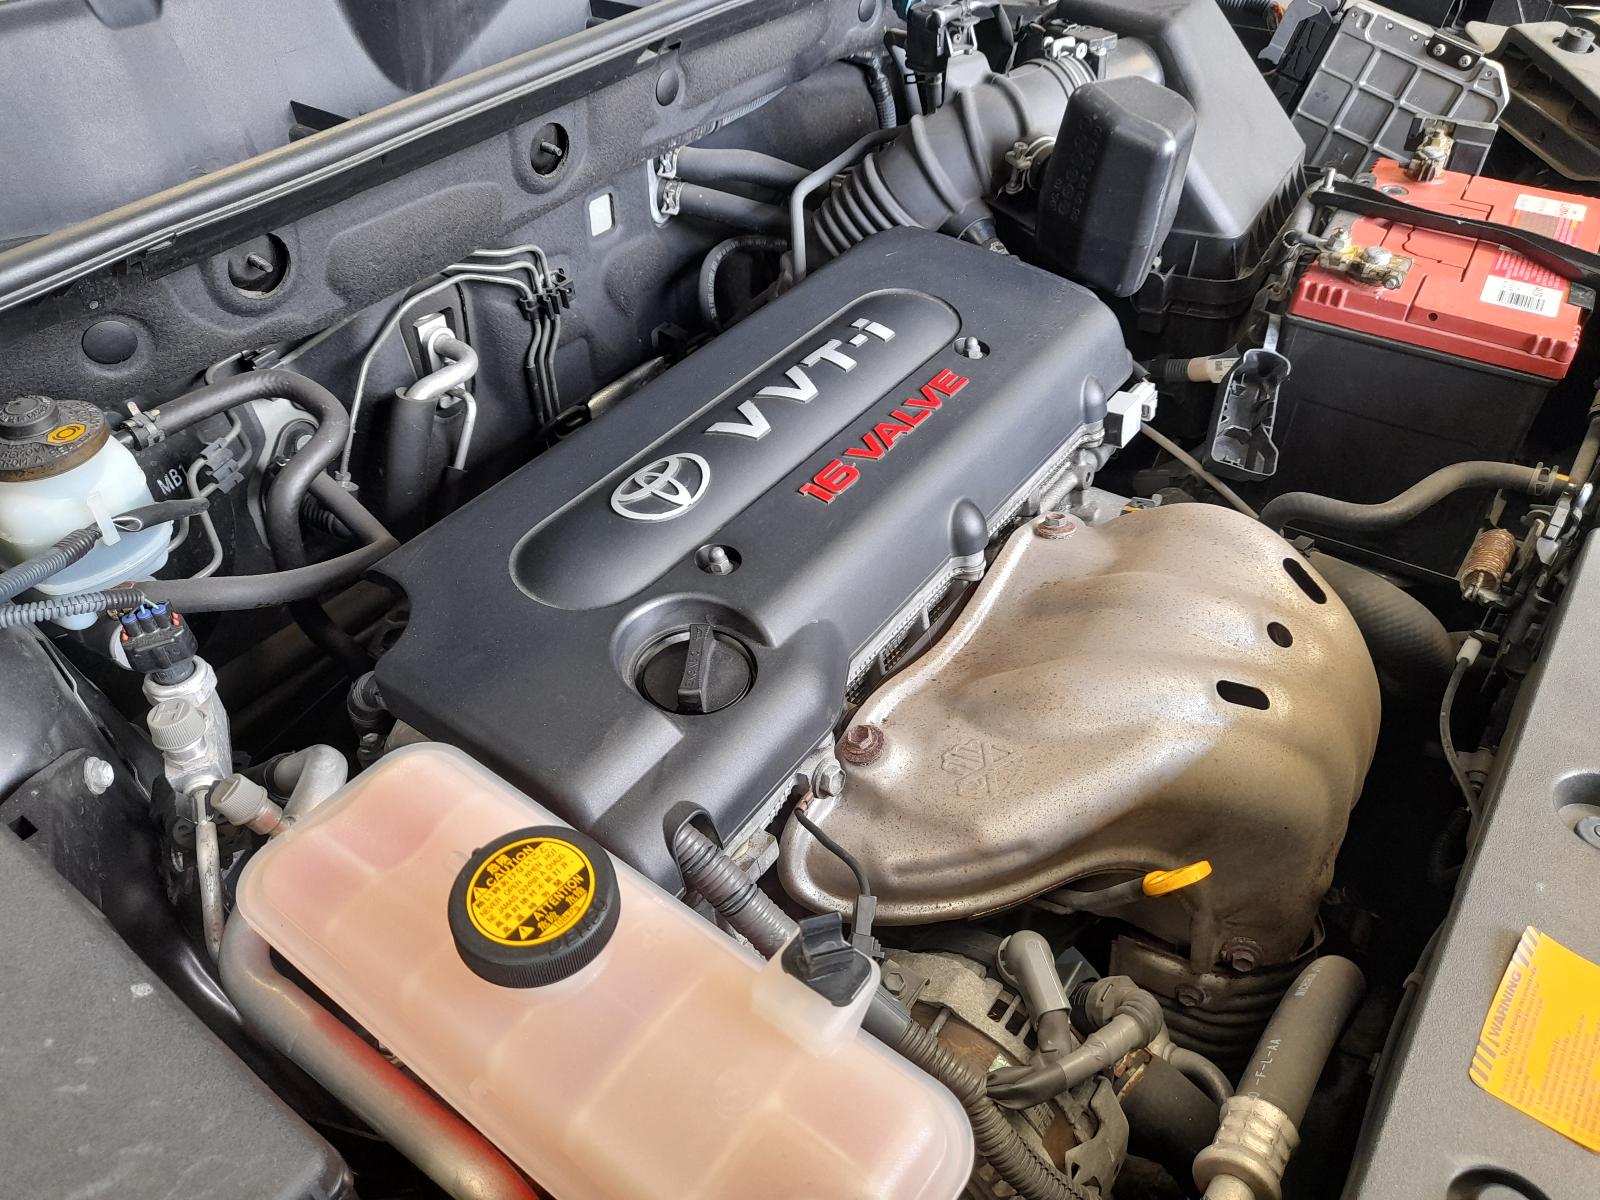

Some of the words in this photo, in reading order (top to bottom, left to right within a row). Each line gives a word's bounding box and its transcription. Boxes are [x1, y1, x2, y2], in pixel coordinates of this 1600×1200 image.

[704, 318, 896, 440] VVT-i
[798, 458, 861, 504] 16
[842, 368, 970, 460] VALVE
[486, 845, 535, 887] CAUTION
[533, 873, 585, 921] ATTENTION
[1488, 970, 1522, 1037] WARNING
